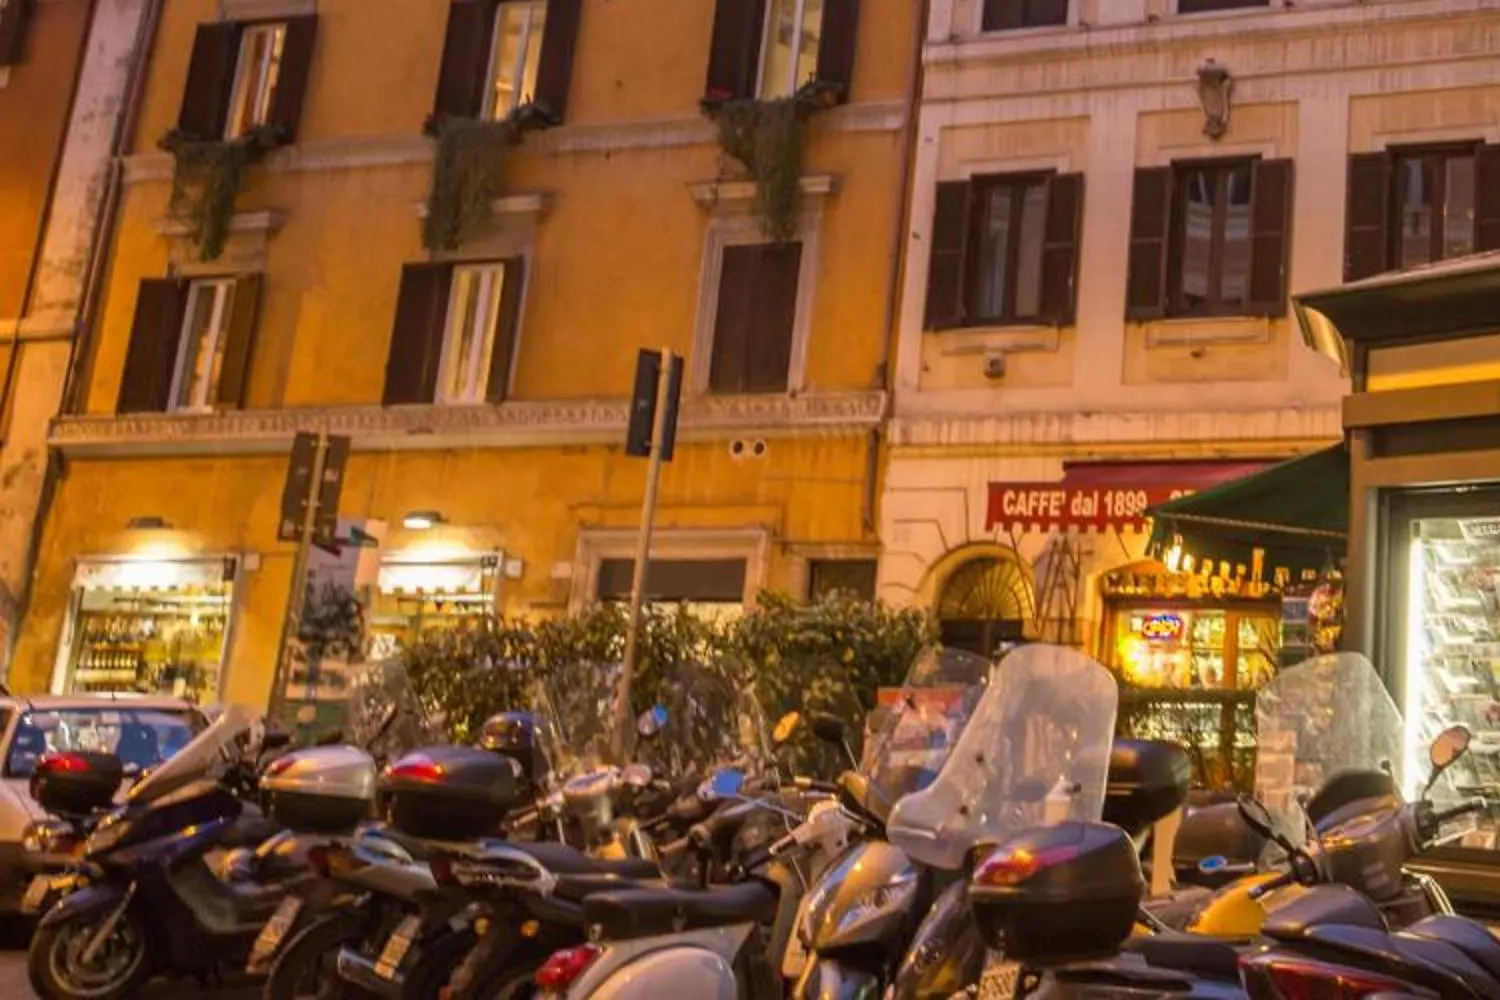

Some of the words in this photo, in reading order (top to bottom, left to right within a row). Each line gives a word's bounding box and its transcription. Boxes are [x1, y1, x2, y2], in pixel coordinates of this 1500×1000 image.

[1002, 489, 1066, 516] CAFFE'
[1070, 490, 1098, 516] dal
[1104, 489, 1148, 516] 1899
